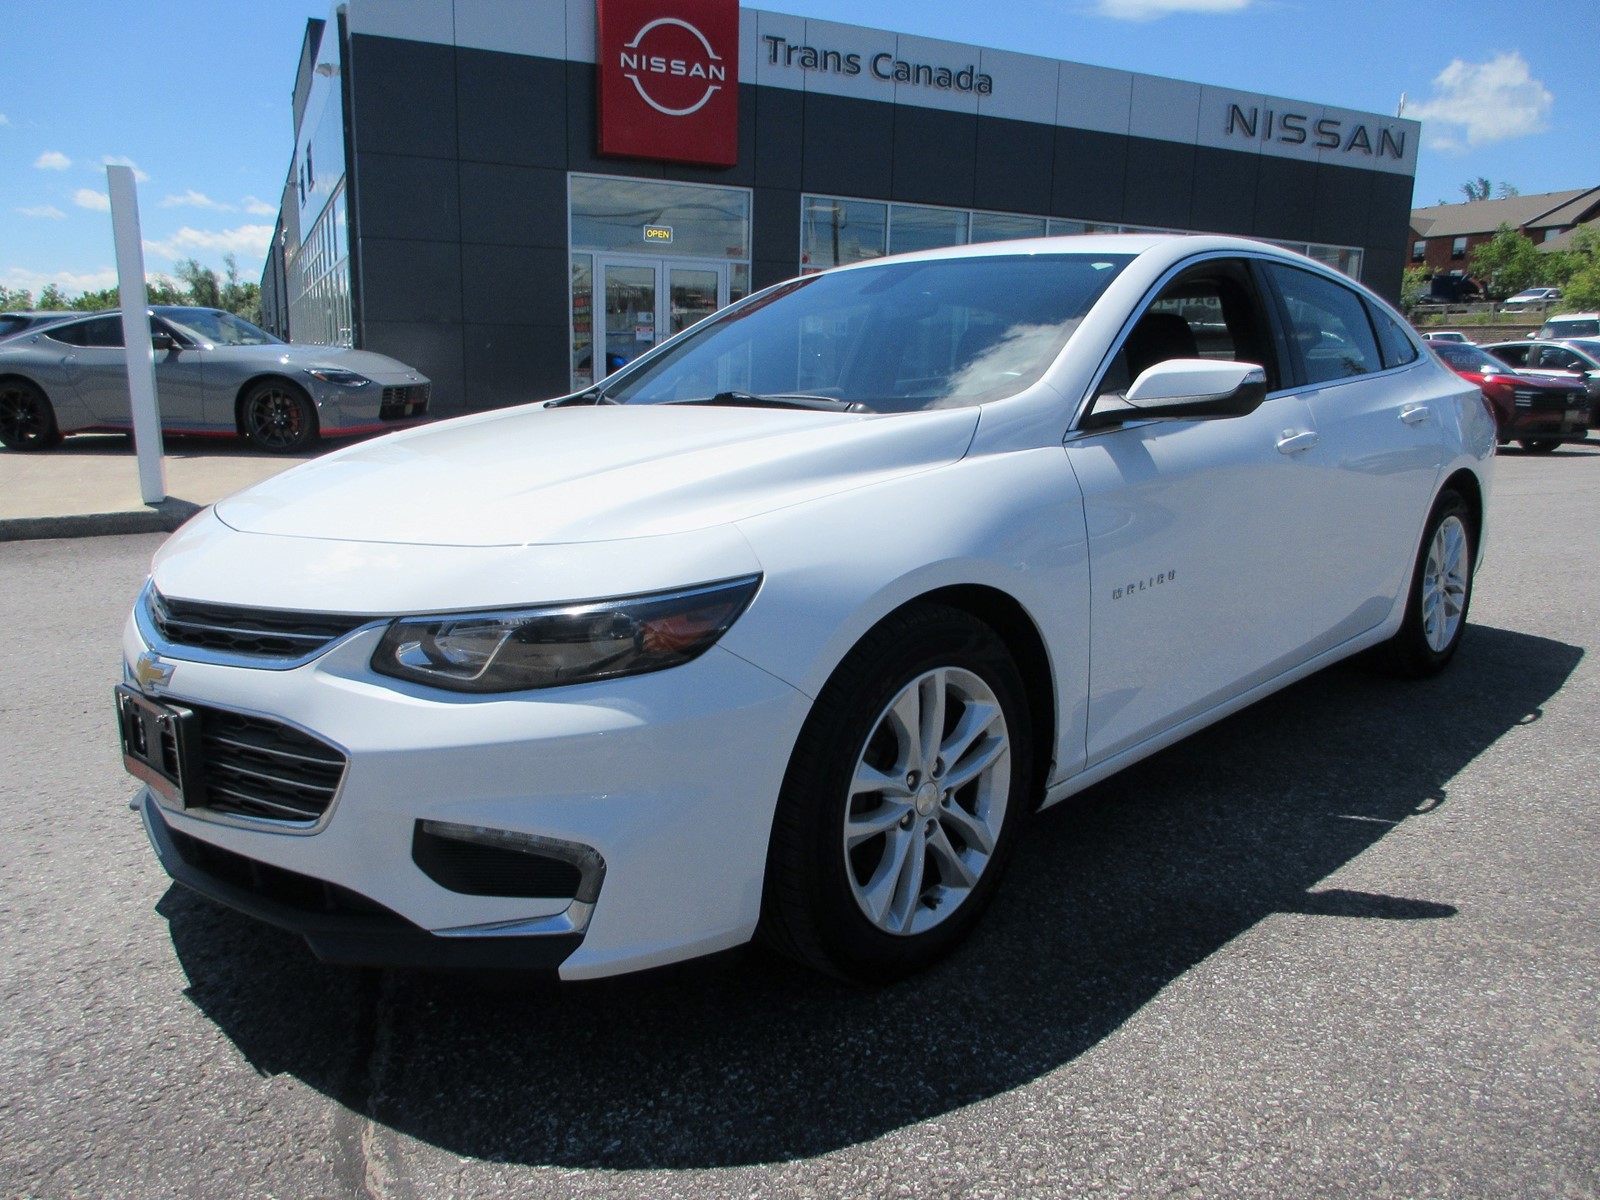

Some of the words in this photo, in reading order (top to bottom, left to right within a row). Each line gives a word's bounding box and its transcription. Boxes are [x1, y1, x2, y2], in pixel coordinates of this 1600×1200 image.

[621, 52, 725, 81] NISSAN
[764, 35, 861, 76] Trans
[870, 52, 993, 96] Canada
[1228, 104, 1406, 159] NISSAN
[646, 229, 670, 239] OPEN
[1112, 569, 1176, 600] MALIBU
